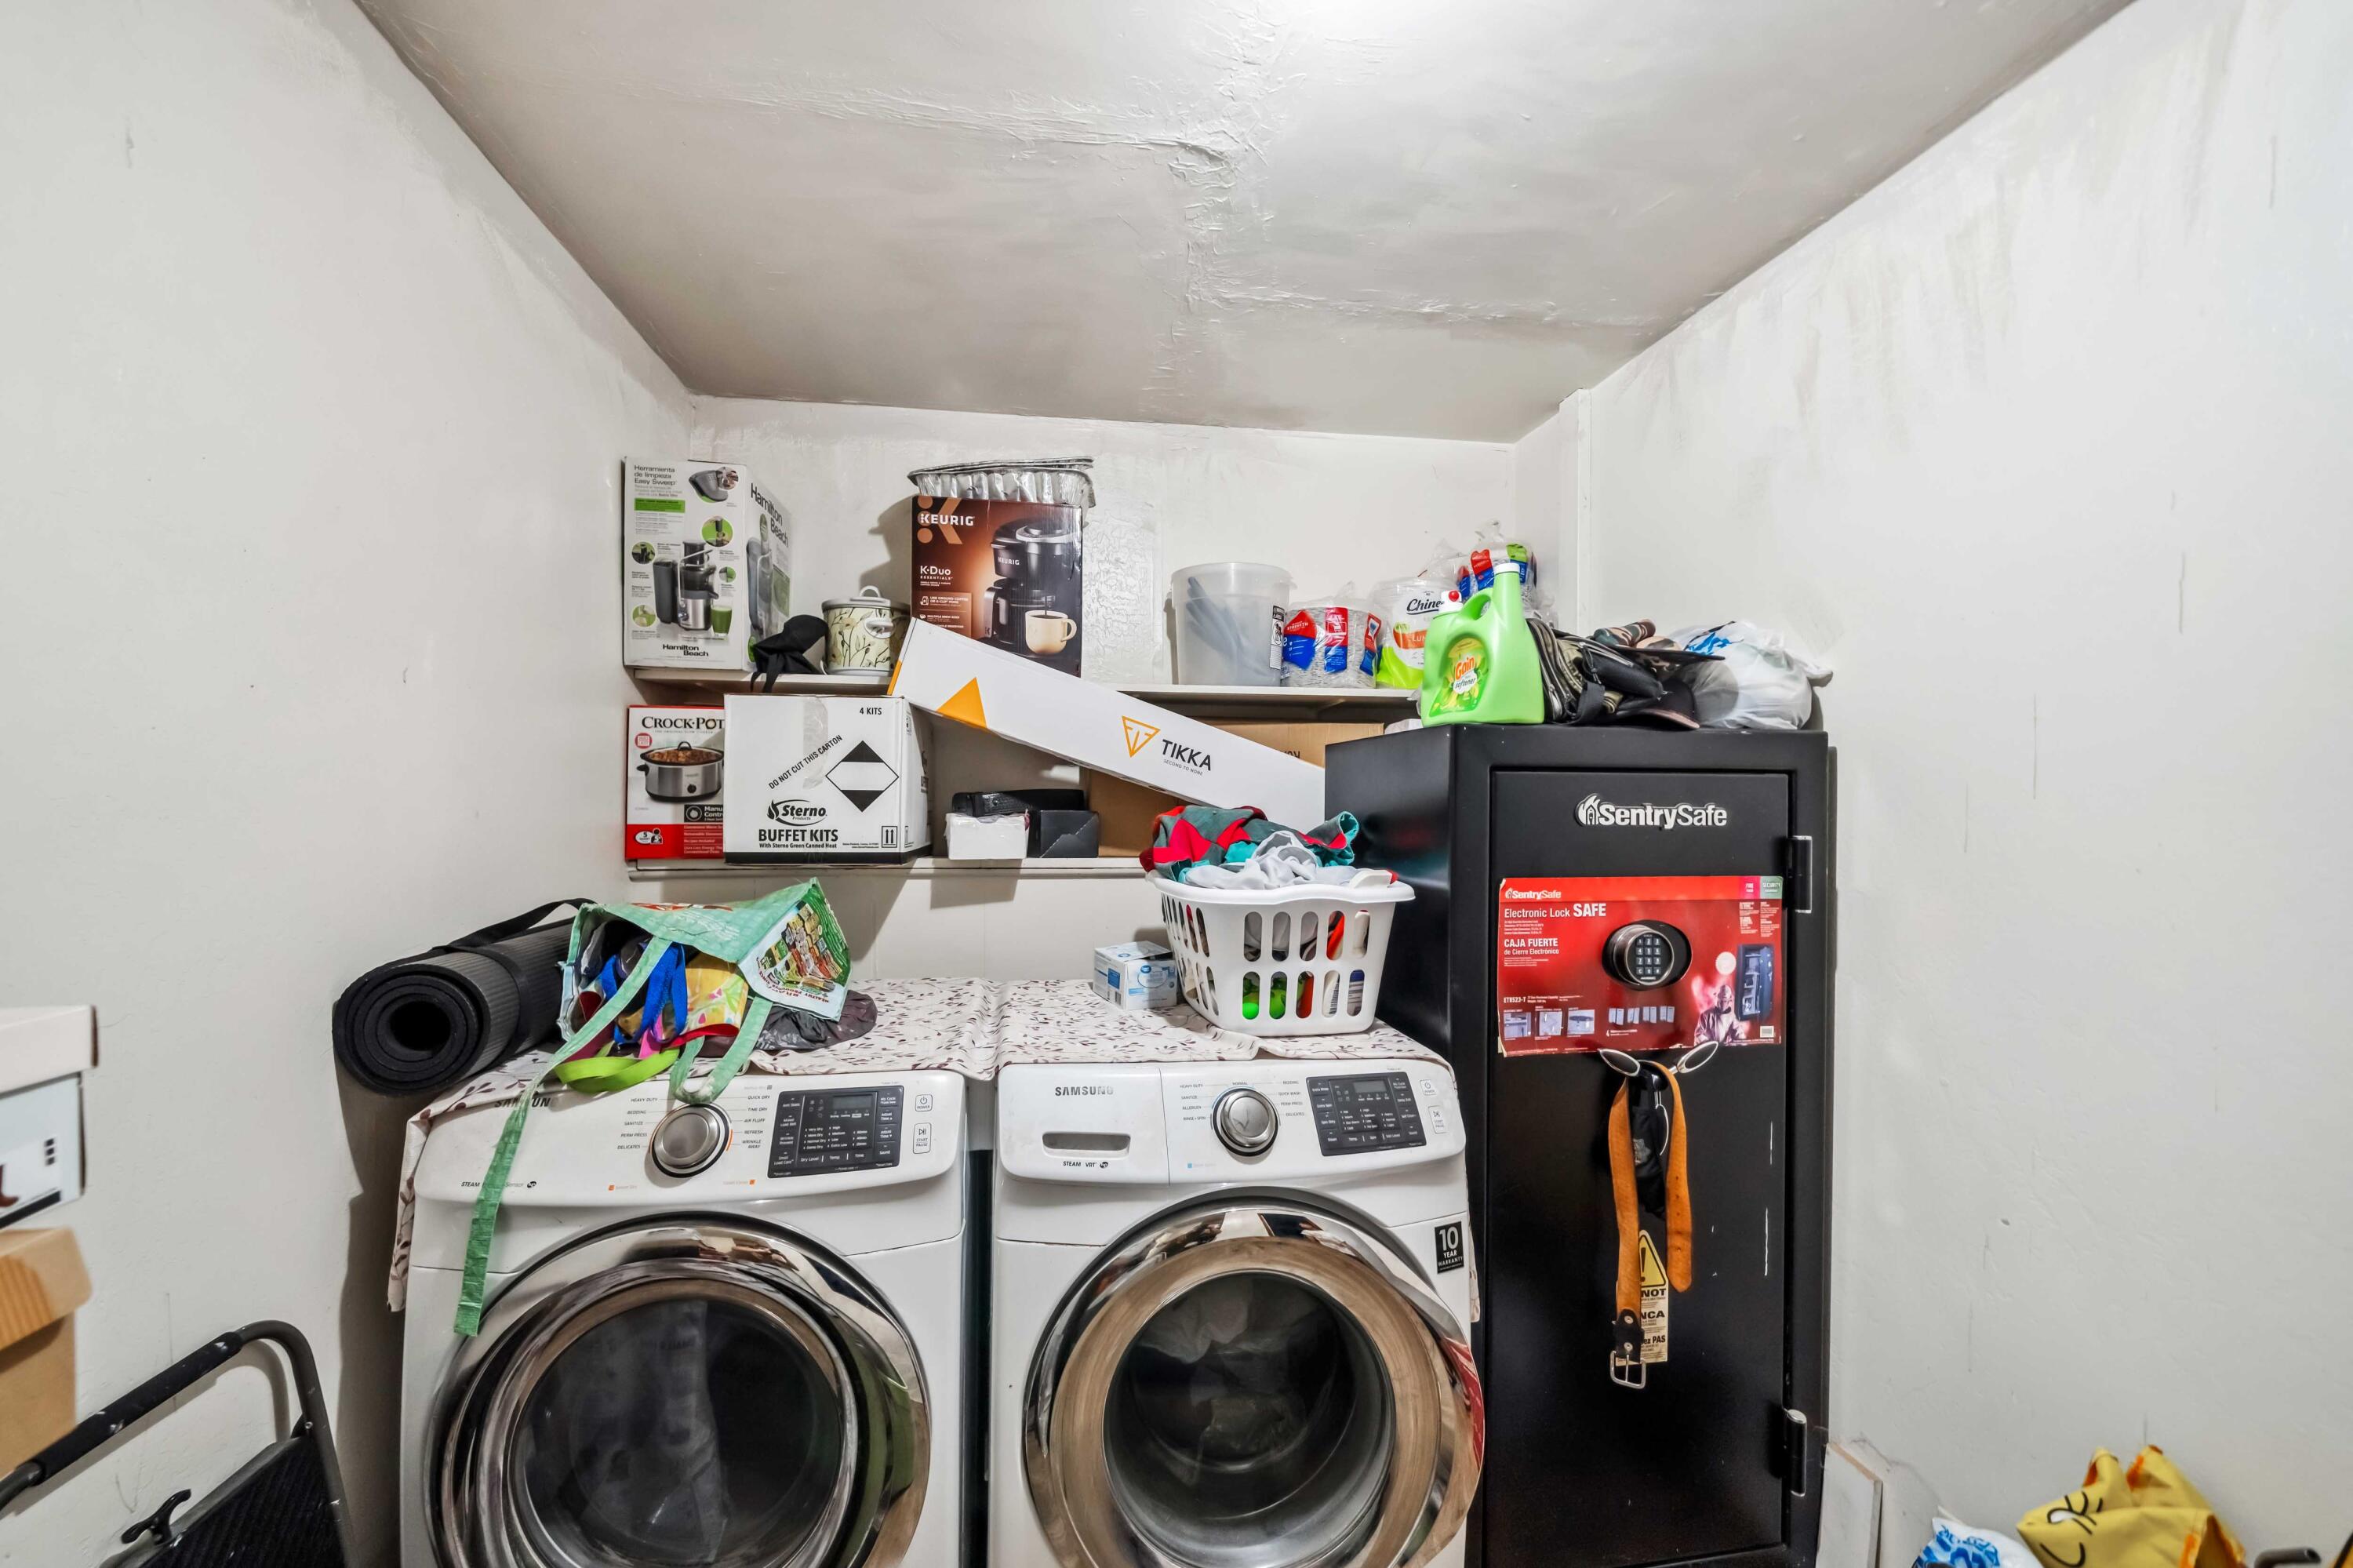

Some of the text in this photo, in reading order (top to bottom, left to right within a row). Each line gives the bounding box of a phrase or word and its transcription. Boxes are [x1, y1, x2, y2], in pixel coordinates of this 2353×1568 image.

[751, 482, 783, 527] Hamilton
[920, 513, 974, 526] KEURIG
[770, 517, 789, 548] Beach
[998, 556, 1020, 566] KEURIG
[1406, 598, 1443, 612] Chine
[1287, 622, 1308, 631] STRENGTH
[1455, 657, 1475, 680] Gain
[1455, 678, 1476, 690] softener
[1162, 739, 1212, 771] TIKKA
[768, 734, 843, 790] DO NOT CUT THIS CARTON
[1163, 759, 1183, 769] SECOND
[1190, 767, 1203, 776] NONE
[781, 805, 827, 817] Sterno
[1599, 804, 1727, 829] SentrySafe
[758, 829, 838, 842] BUFFET KITS
[1512, 890, 1562, 900] SentrySafe
[1504, 903, 1606, 918] Electronic Lock SAFE
[1504, 938, 1558, 948] CAJA FUERTE
[758, 970, 770, 985] SINCE
[805, 992, 829, 1002] HEALTHY
[1055, 1086, 1114, 1097] SAMSUNG
[1439, 1226, 1459, 1251] 10
[1443, 1250, 1457, 1259] YEAR
[1438, 1256, 1463, 1267] WARRANTY
[1641, 1288, 1667, 1297] NOT
